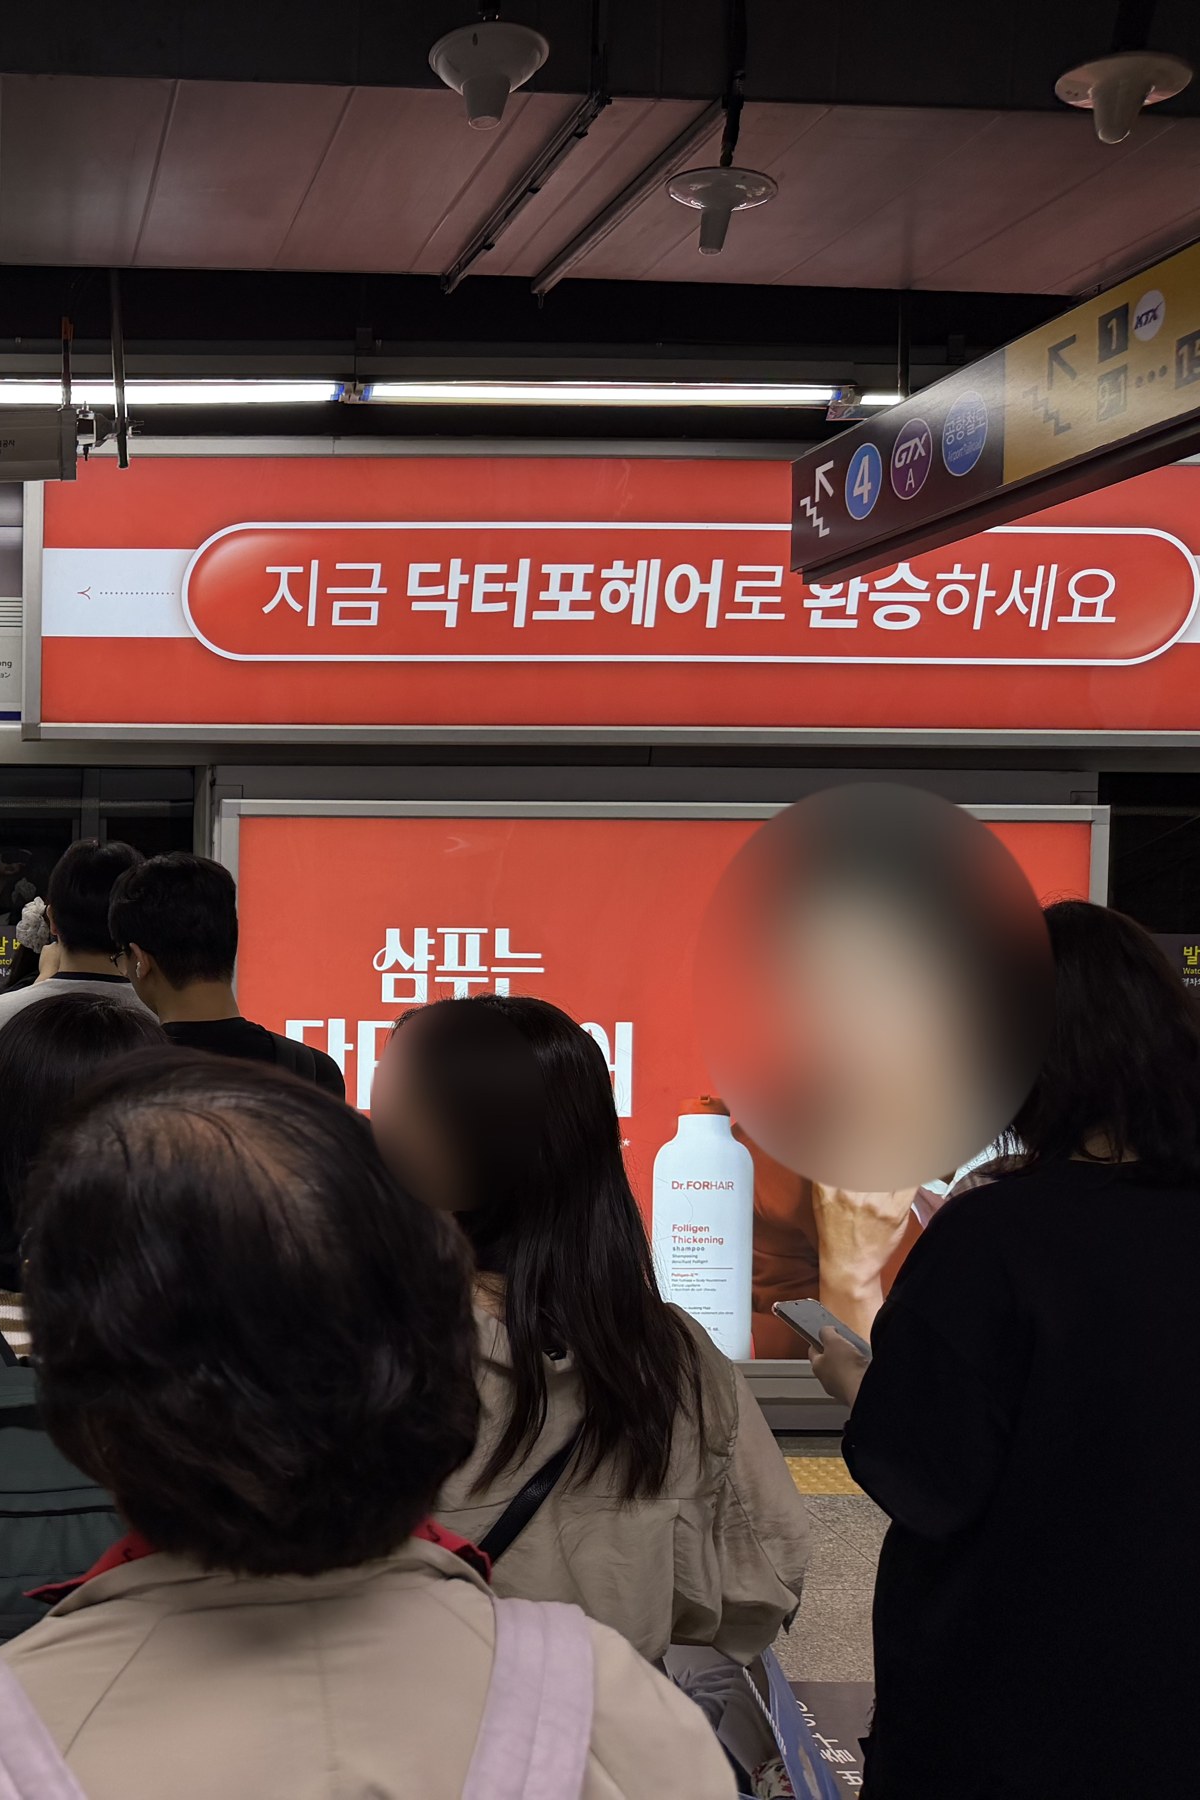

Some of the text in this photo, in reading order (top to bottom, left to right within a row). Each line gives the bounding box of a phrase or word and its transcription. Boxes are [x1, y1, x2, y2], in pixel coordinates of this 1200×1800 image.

[1107, 302, 1163, 350] 1 KTX
[945, 406, 986, 445] 공항철도
[895, 432, 928, 468] GTX
[853, 455, 871, 504] 4
[905, 468, 915, 491] A
[262, 560, 1118, 632] 지금 닥터포헤어로 환승하세요
[373, 927, 545, 1003] 샴푸는
[671, 1180, 734, 1191] Dr.FORHAIR
[672, 1224, 710, 1234] Folligen
[672, 1235, 724, 1246] Thickening
